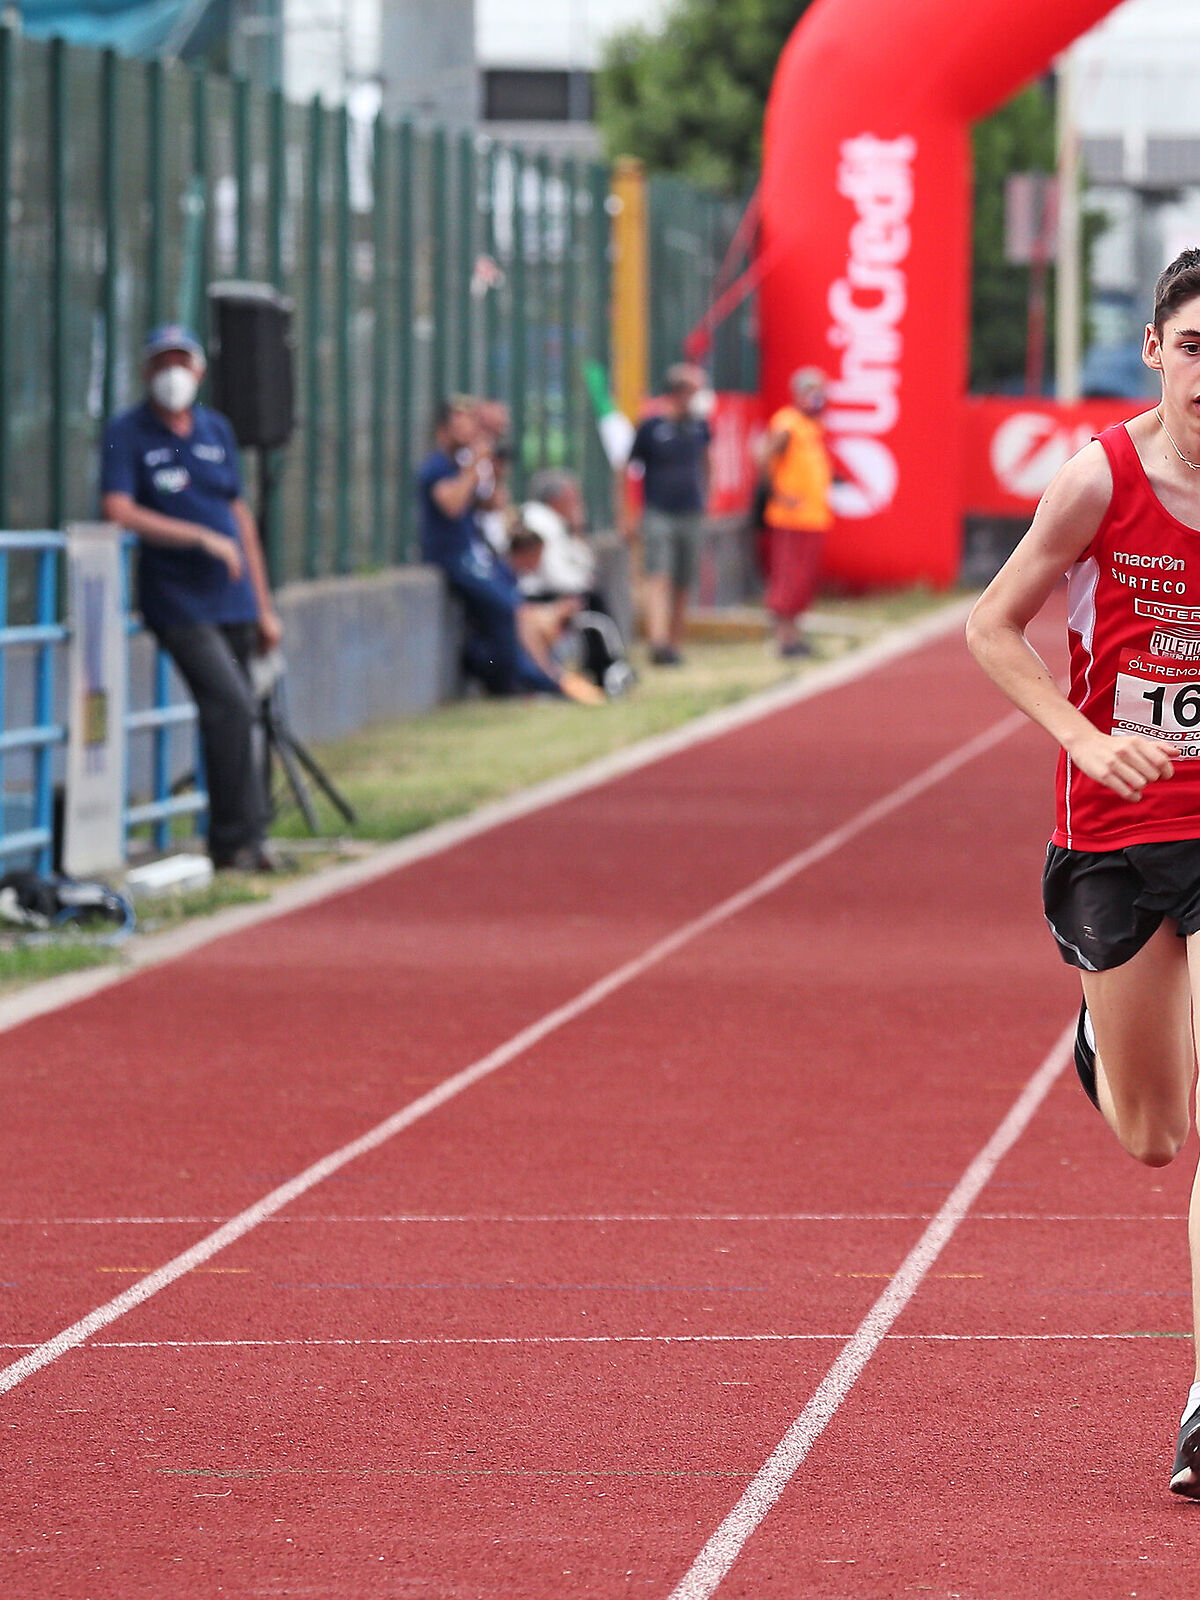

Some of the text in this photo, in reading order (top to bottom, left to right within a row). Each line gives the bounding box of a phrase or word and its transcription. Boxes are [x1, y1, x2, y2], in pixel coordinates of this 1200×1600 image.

[826, 132, 917, 436] UniCredit
[1113, 551, 1185, 571] macron
[1111, 567, 1186, 594] SURTECO
[1118, 721, 1183, 741] CONCESIO
